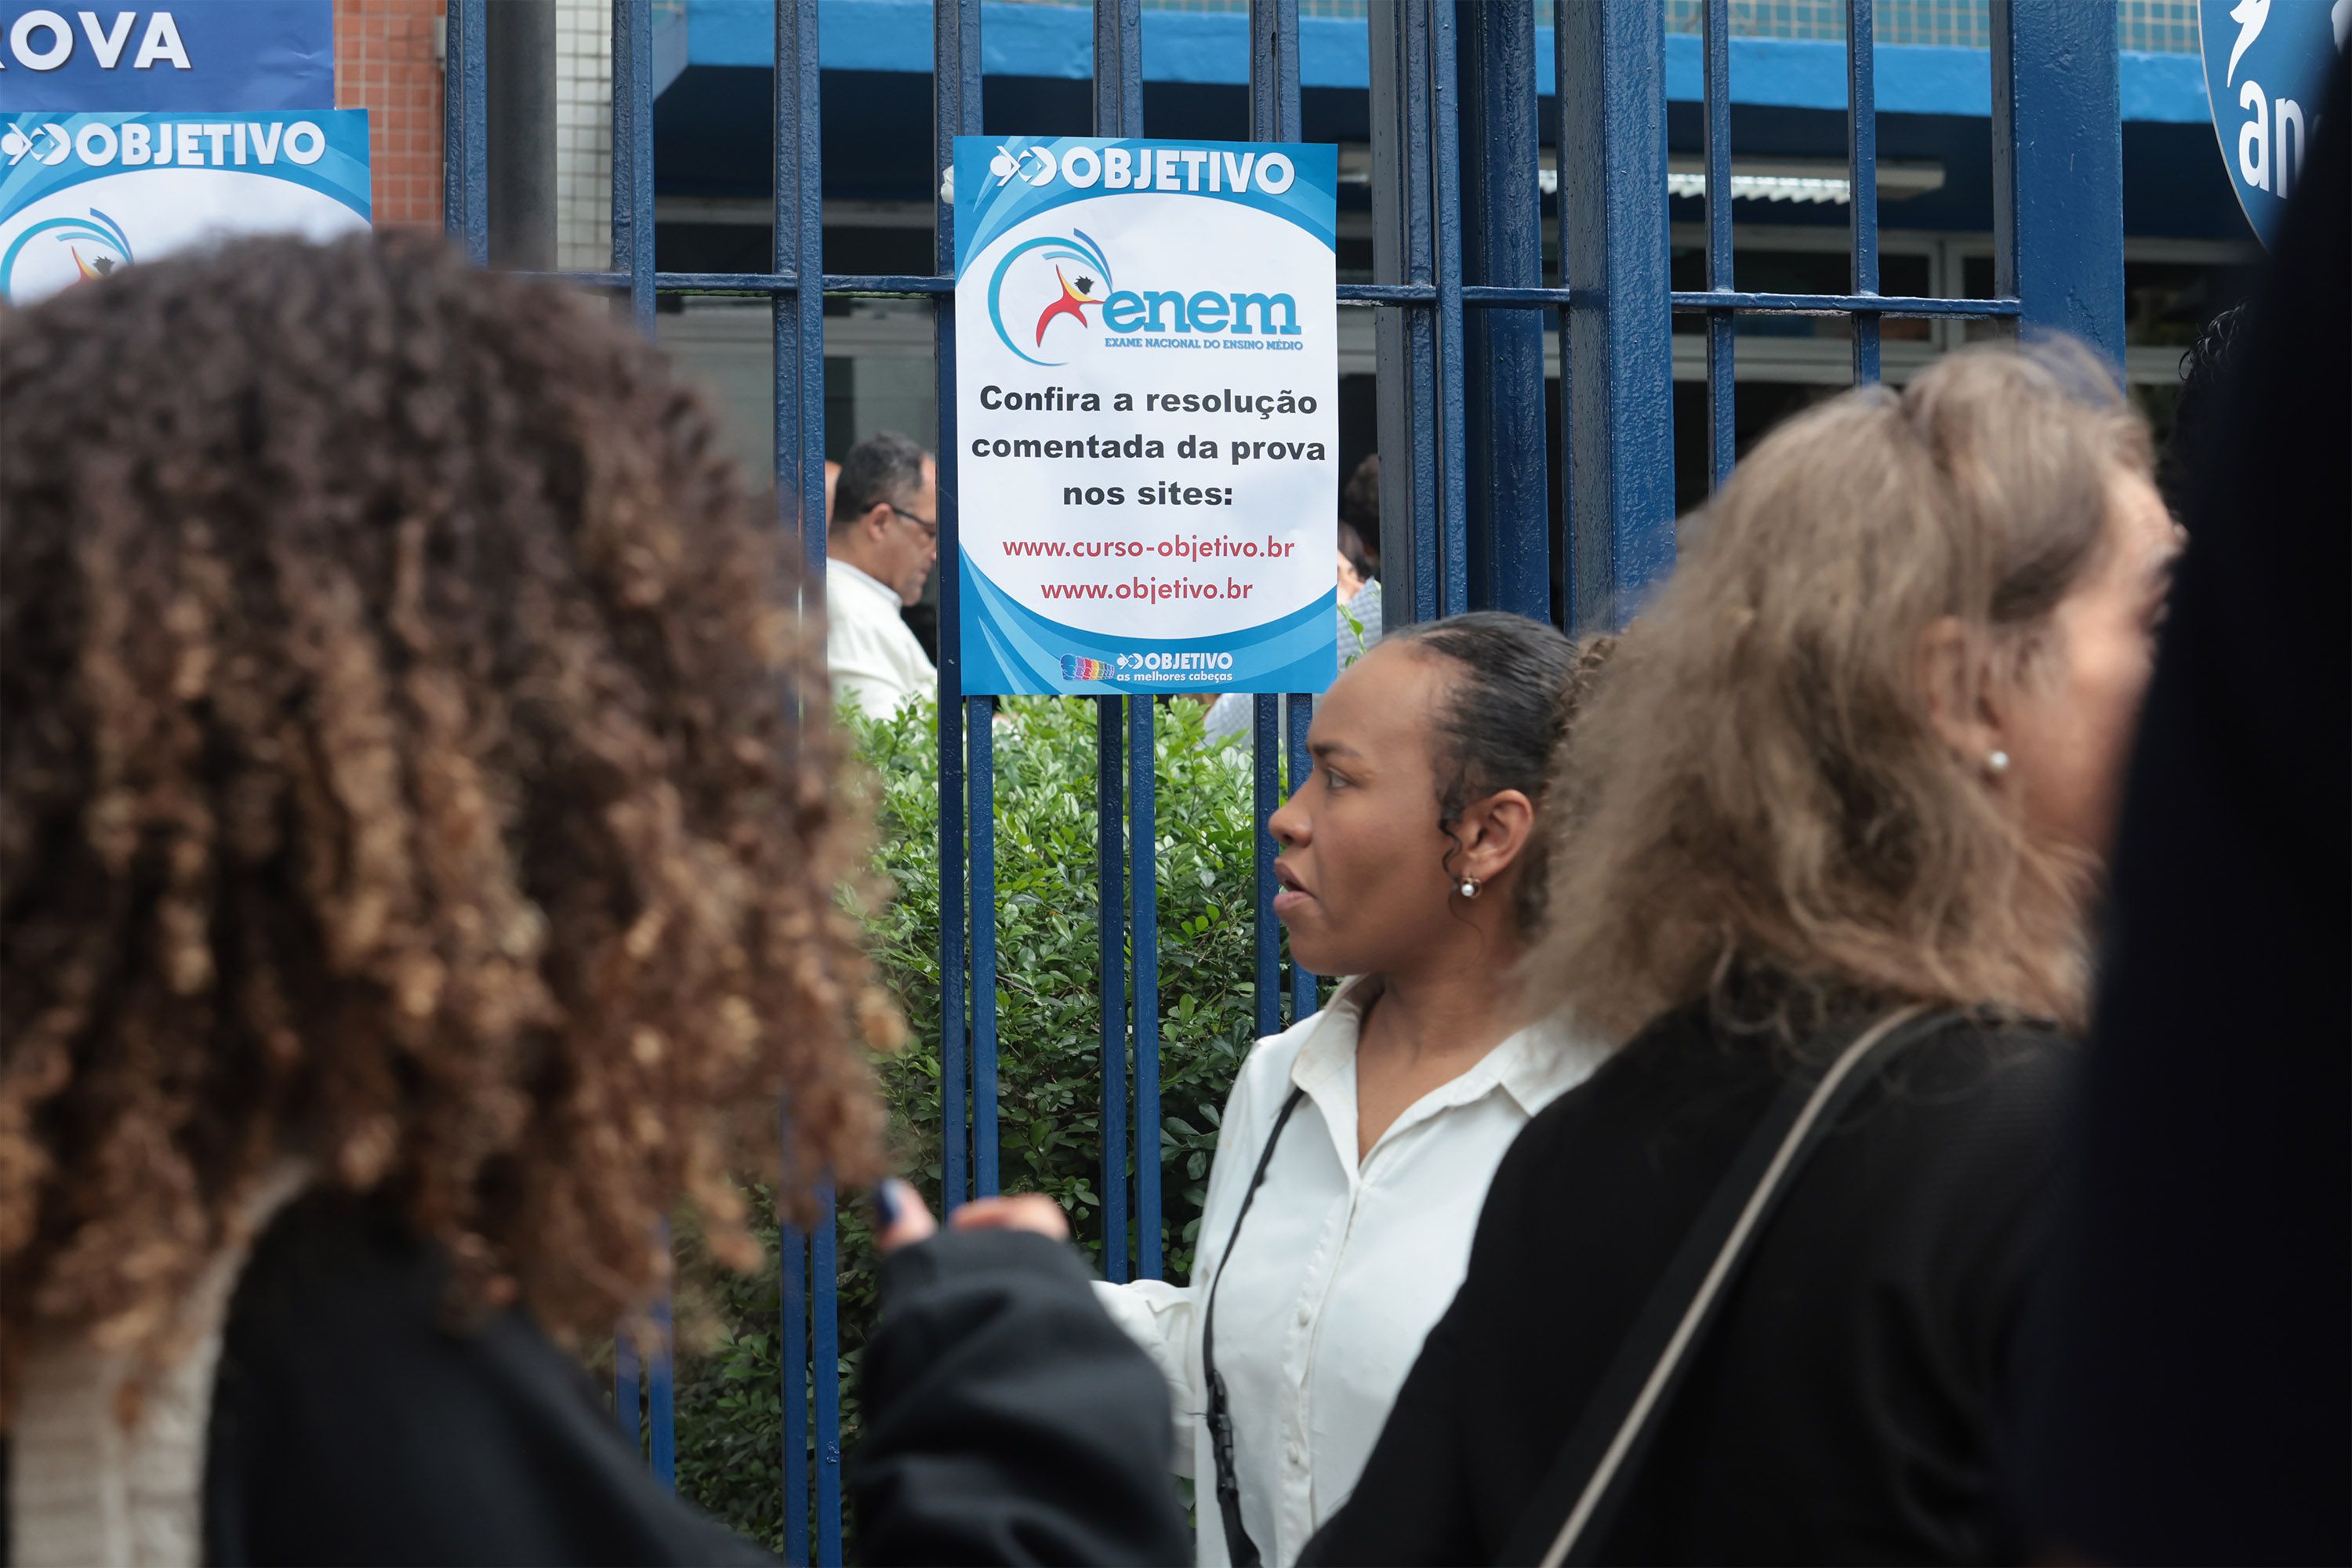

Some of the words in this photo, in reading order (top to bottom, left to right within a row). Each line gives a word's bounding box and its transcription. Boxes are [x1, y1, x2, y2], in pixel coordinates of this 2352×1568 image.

[0, 9, 191, 71] OVA
[76, 121, 325, 166] OBJETIVO
[1062, 146, 1295, 194] OBJETIVO
[1102, 291, 1301, 335] enem
[1105, 338, 1142, 348] EXAME
[1145, 339, 1200, 349] NACIONAL
[1203, 339, 1221, 350] DO
[1223, 340, 1264, 350] ENSINO
[1266, 339, 1303, 350] MÉDIO
[980, 385, 1100, 412] Confira
[1113, 394, 1133, 412] a
[1146, 389, 1318, 419] resolução
[971, 434, 1165, 459] comentada
[1178, 435, 1218, 459] da
[1232, 441, 1326, 465] prova
[1063, 485, 1125, 506] nos
[1138, 481, 1233, 506] sites:
[1003, 535, 1294, 562] www.curso-objetivo.br
[1041, 577, 1253, 604] www.objetivo.br
[1145, 652, 1233, 670] OBJETIVO
[1116, 673, 1131, 681] as
[1134, 671, 1185, 681] melhores
[1189, 671, 1233, 683] cabeças
